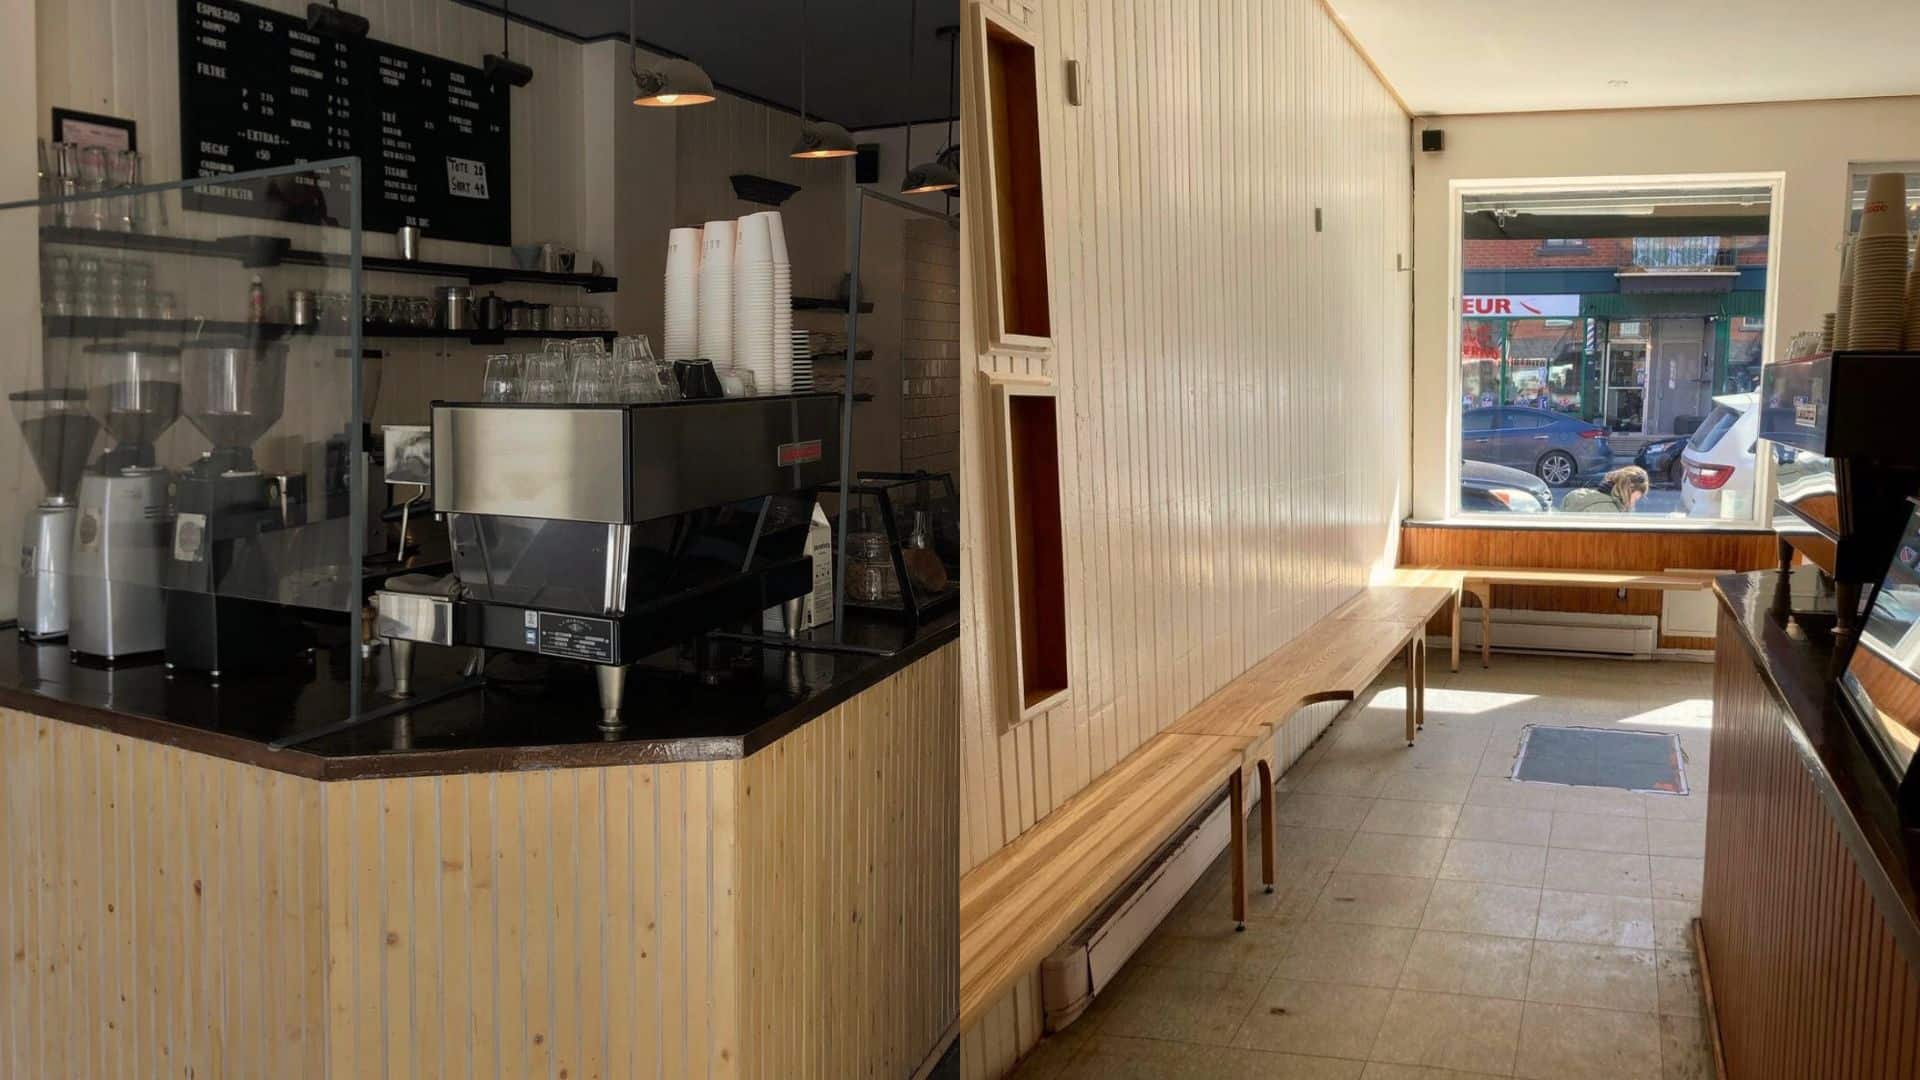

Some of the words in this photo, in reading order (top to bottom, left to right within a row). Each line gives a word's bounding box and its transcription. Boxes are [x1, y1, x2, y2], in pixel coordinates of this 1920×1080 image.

[196, 1, 240, 24] ESPRESSO
[197, 61, 227, 79] FILTRE
[200, 140, 230, 157] DECAF
[1462, 298, 1512, 314] EUR
